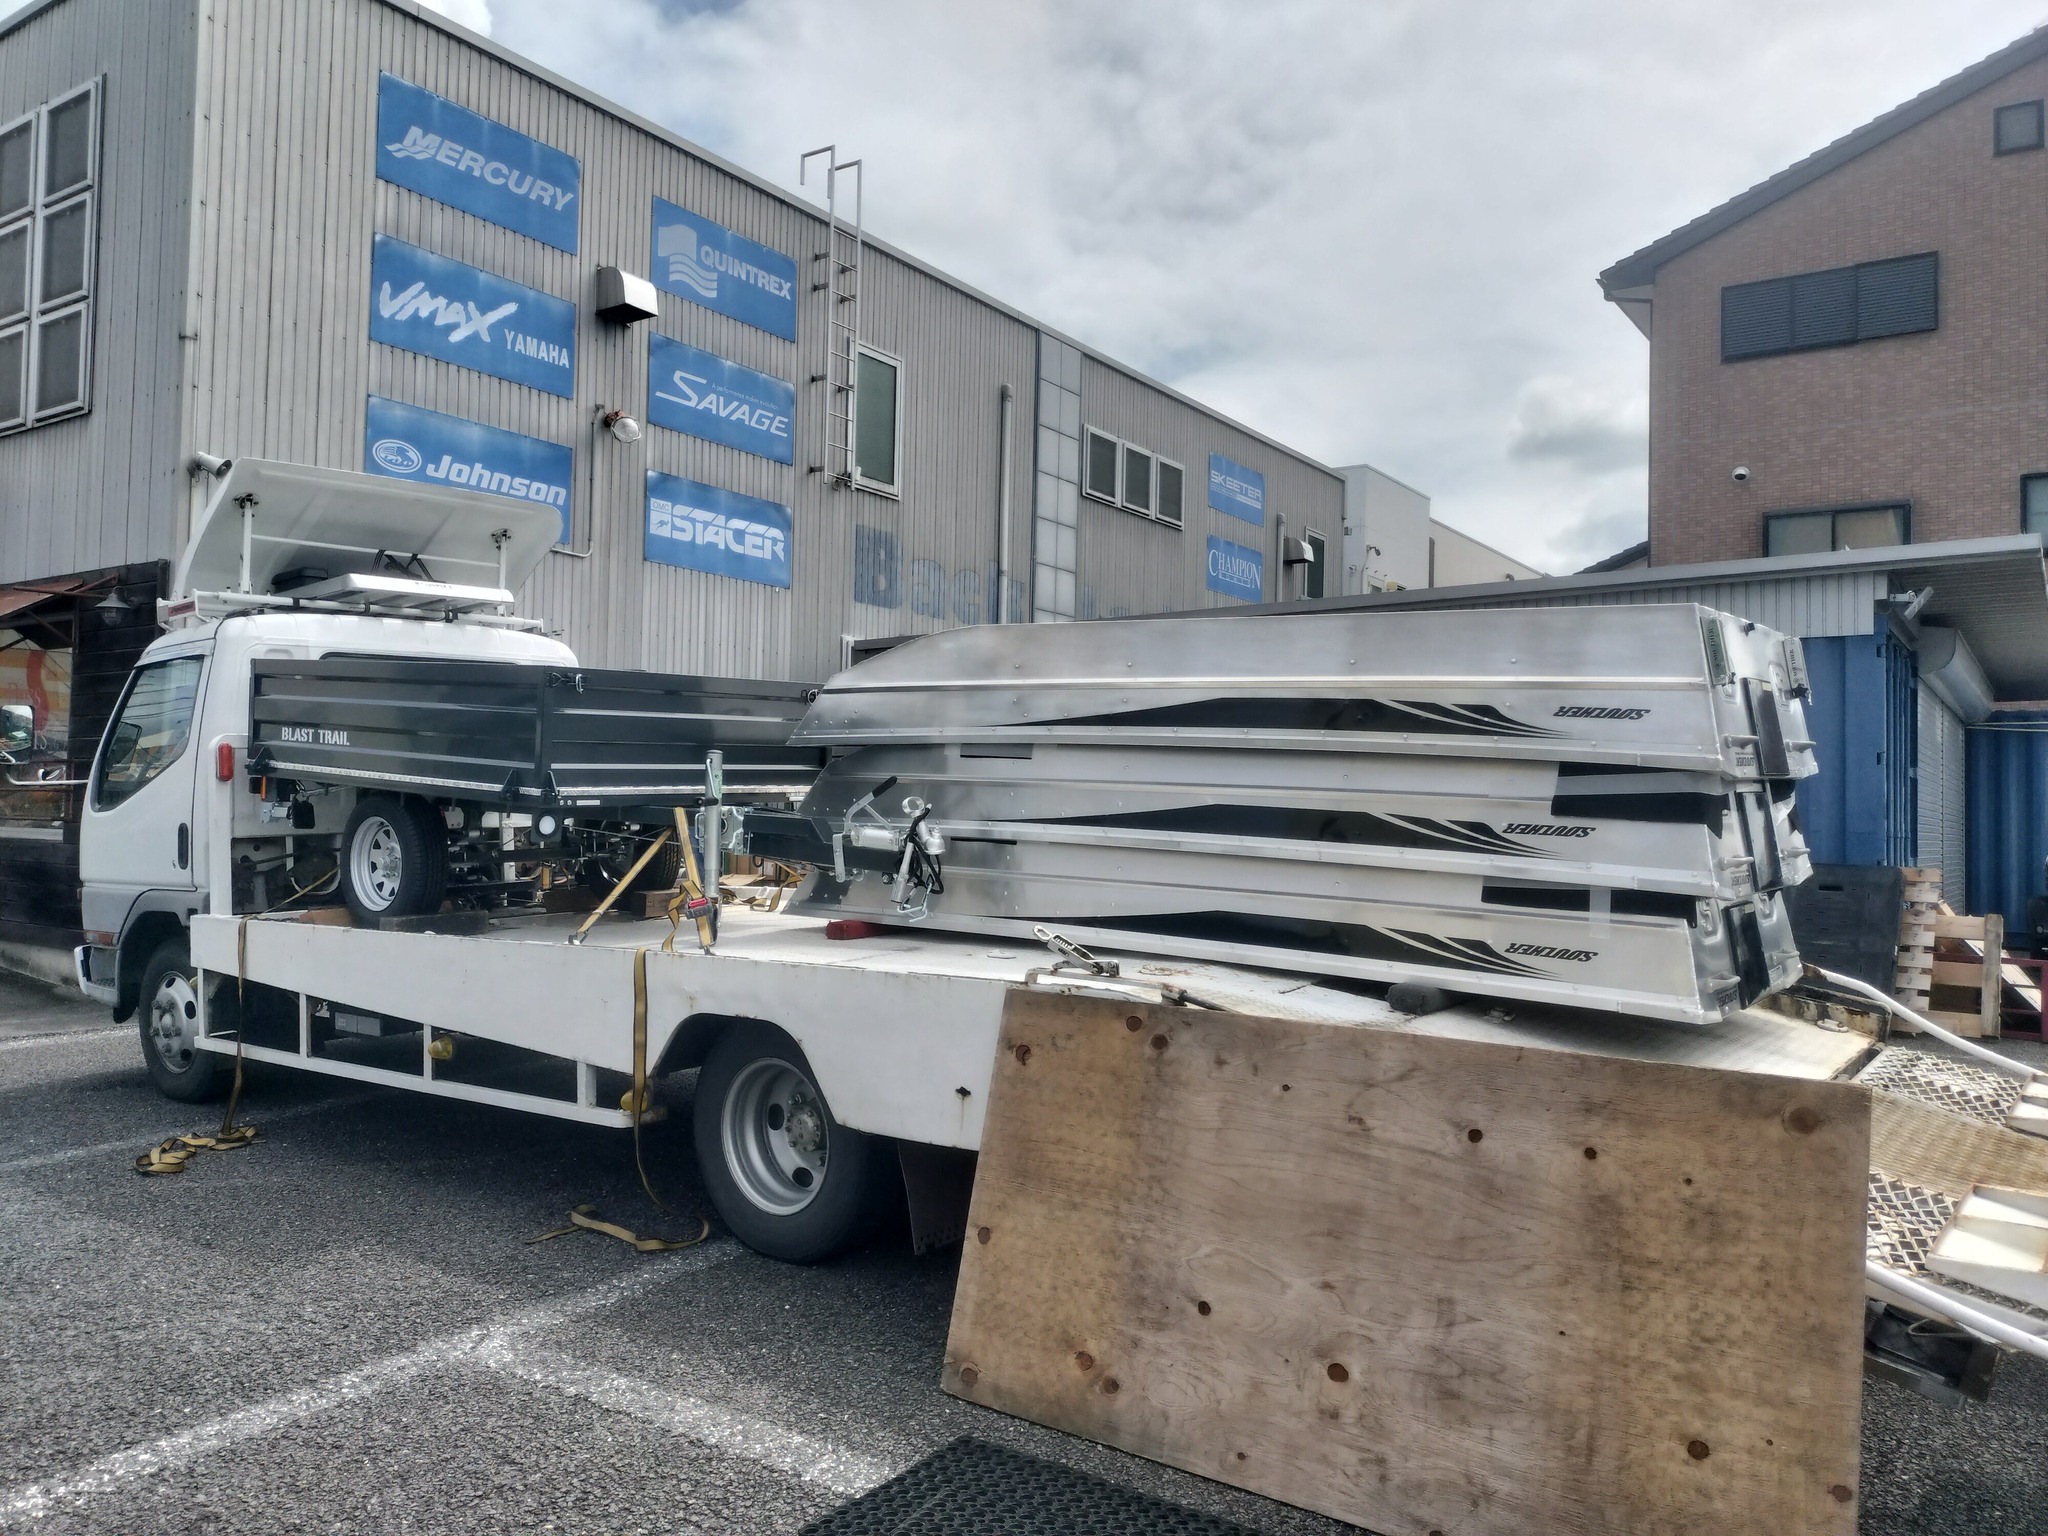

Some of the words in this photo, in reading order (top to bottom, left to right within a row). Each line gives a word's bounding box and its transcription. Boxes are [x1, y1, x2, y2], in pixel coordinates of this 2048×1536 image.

[402, 125, 574, 211] MERCURY
[700, 245, 792, 301] QUINTREX
[504, 328, 570, 369] YAMAHA
[655, 370, 789, 438] SAVAGE
[425, 455, 567, 506] Johnson
[1211, 470, 1262, 501] SKEETER
[652, 501, 670, 512] OMC
[671, 504, 785, 562] STACER
[1208, 549, 1262, 590] CHAMPION
[1552, 705, 1651, 721] SOUTHER
[281, 726, 315, 742] BLAST
[317, 729, 350, 746] TRAIL
[1501, 822, 1597, 838] SOUTHER
[1504, 942, 1599, 962] SOUTHER
